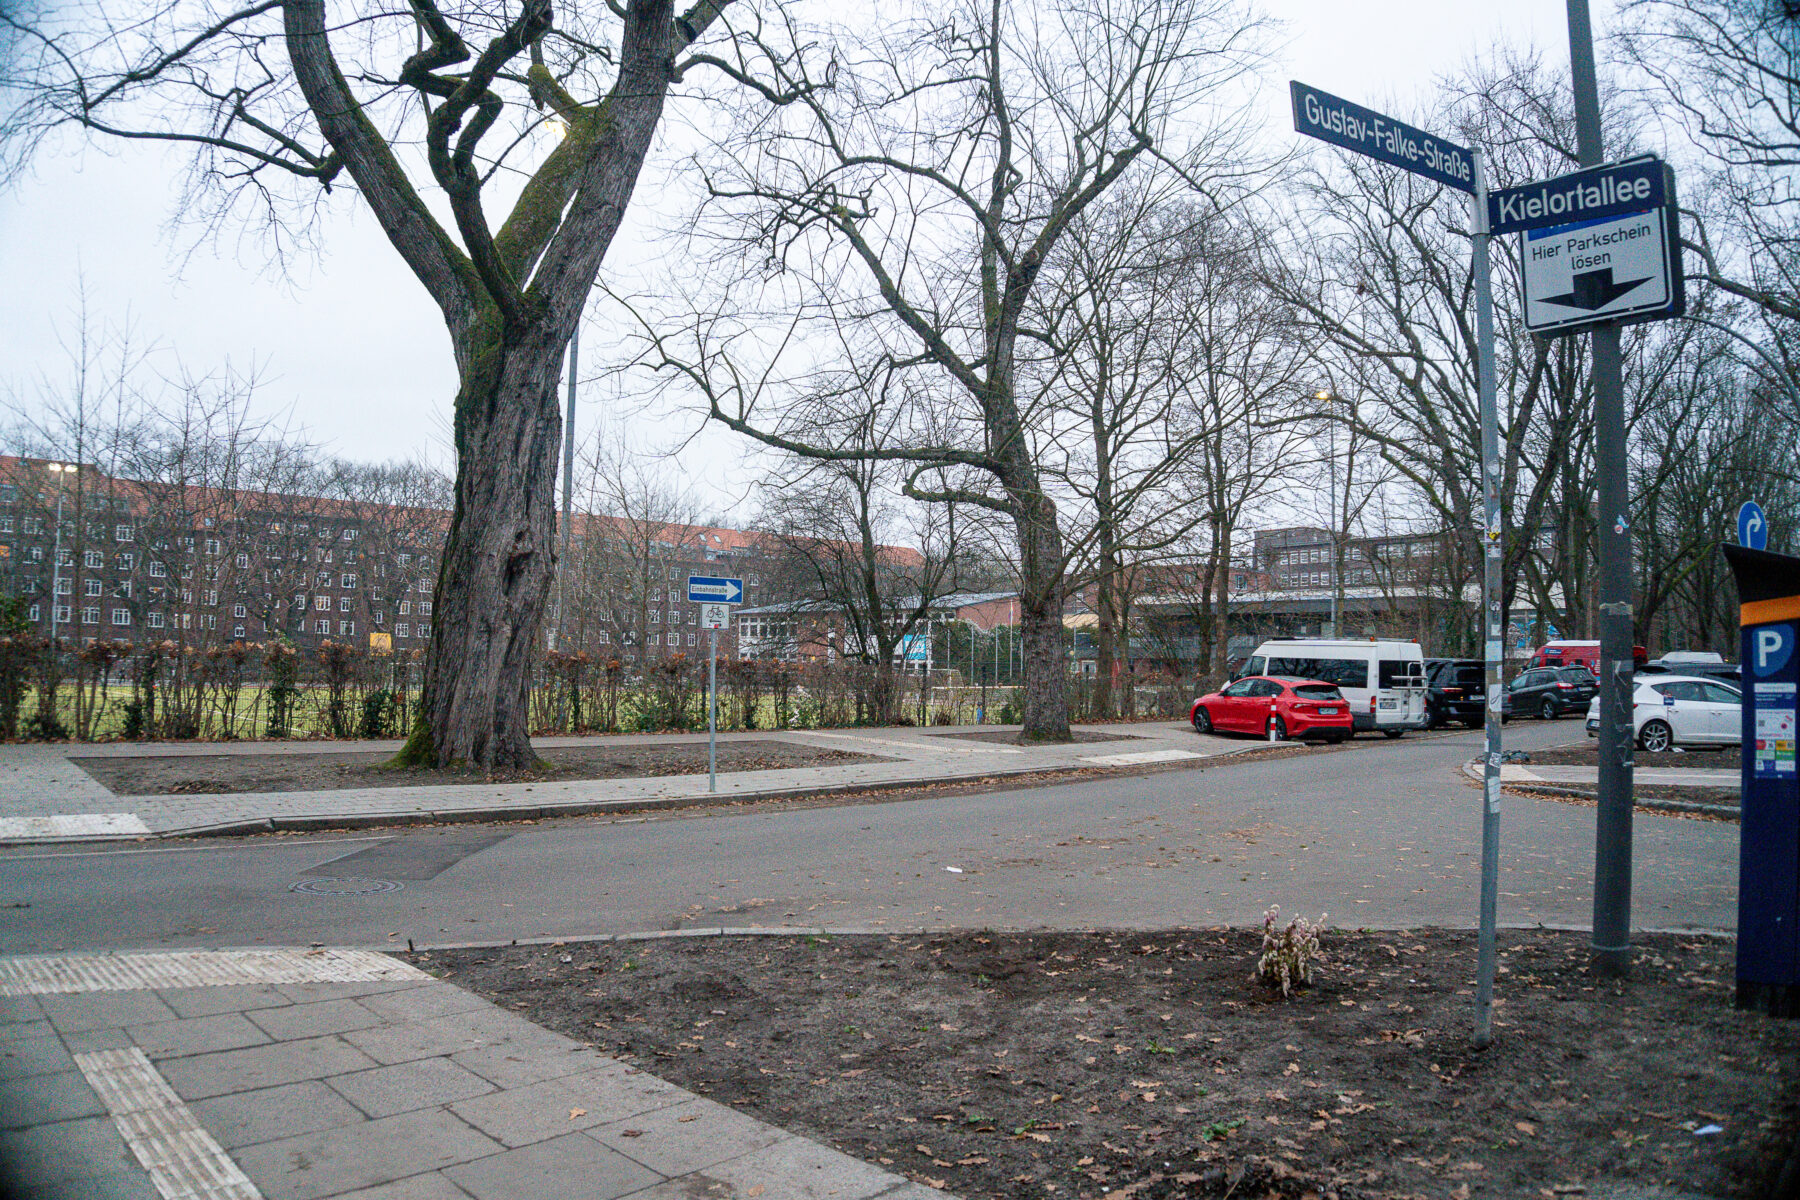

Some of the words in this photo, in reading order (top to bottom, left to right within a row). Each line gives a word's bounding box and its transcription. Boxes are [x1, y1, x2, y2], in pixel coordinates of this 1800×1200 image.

[1304, 93, 1471, 182] Gustav-Falke-Straße
[1499, 175, 1651, 222] Kielortallee
[1532, 244, 1562, 261] Hier
[1567, 223, 1651, 253] Parkschein
[1571, 252, 1611, 270] lösen
[691, 585, 728, 593] Einbahnstraße
[1758, 630, 1782, 667] P
